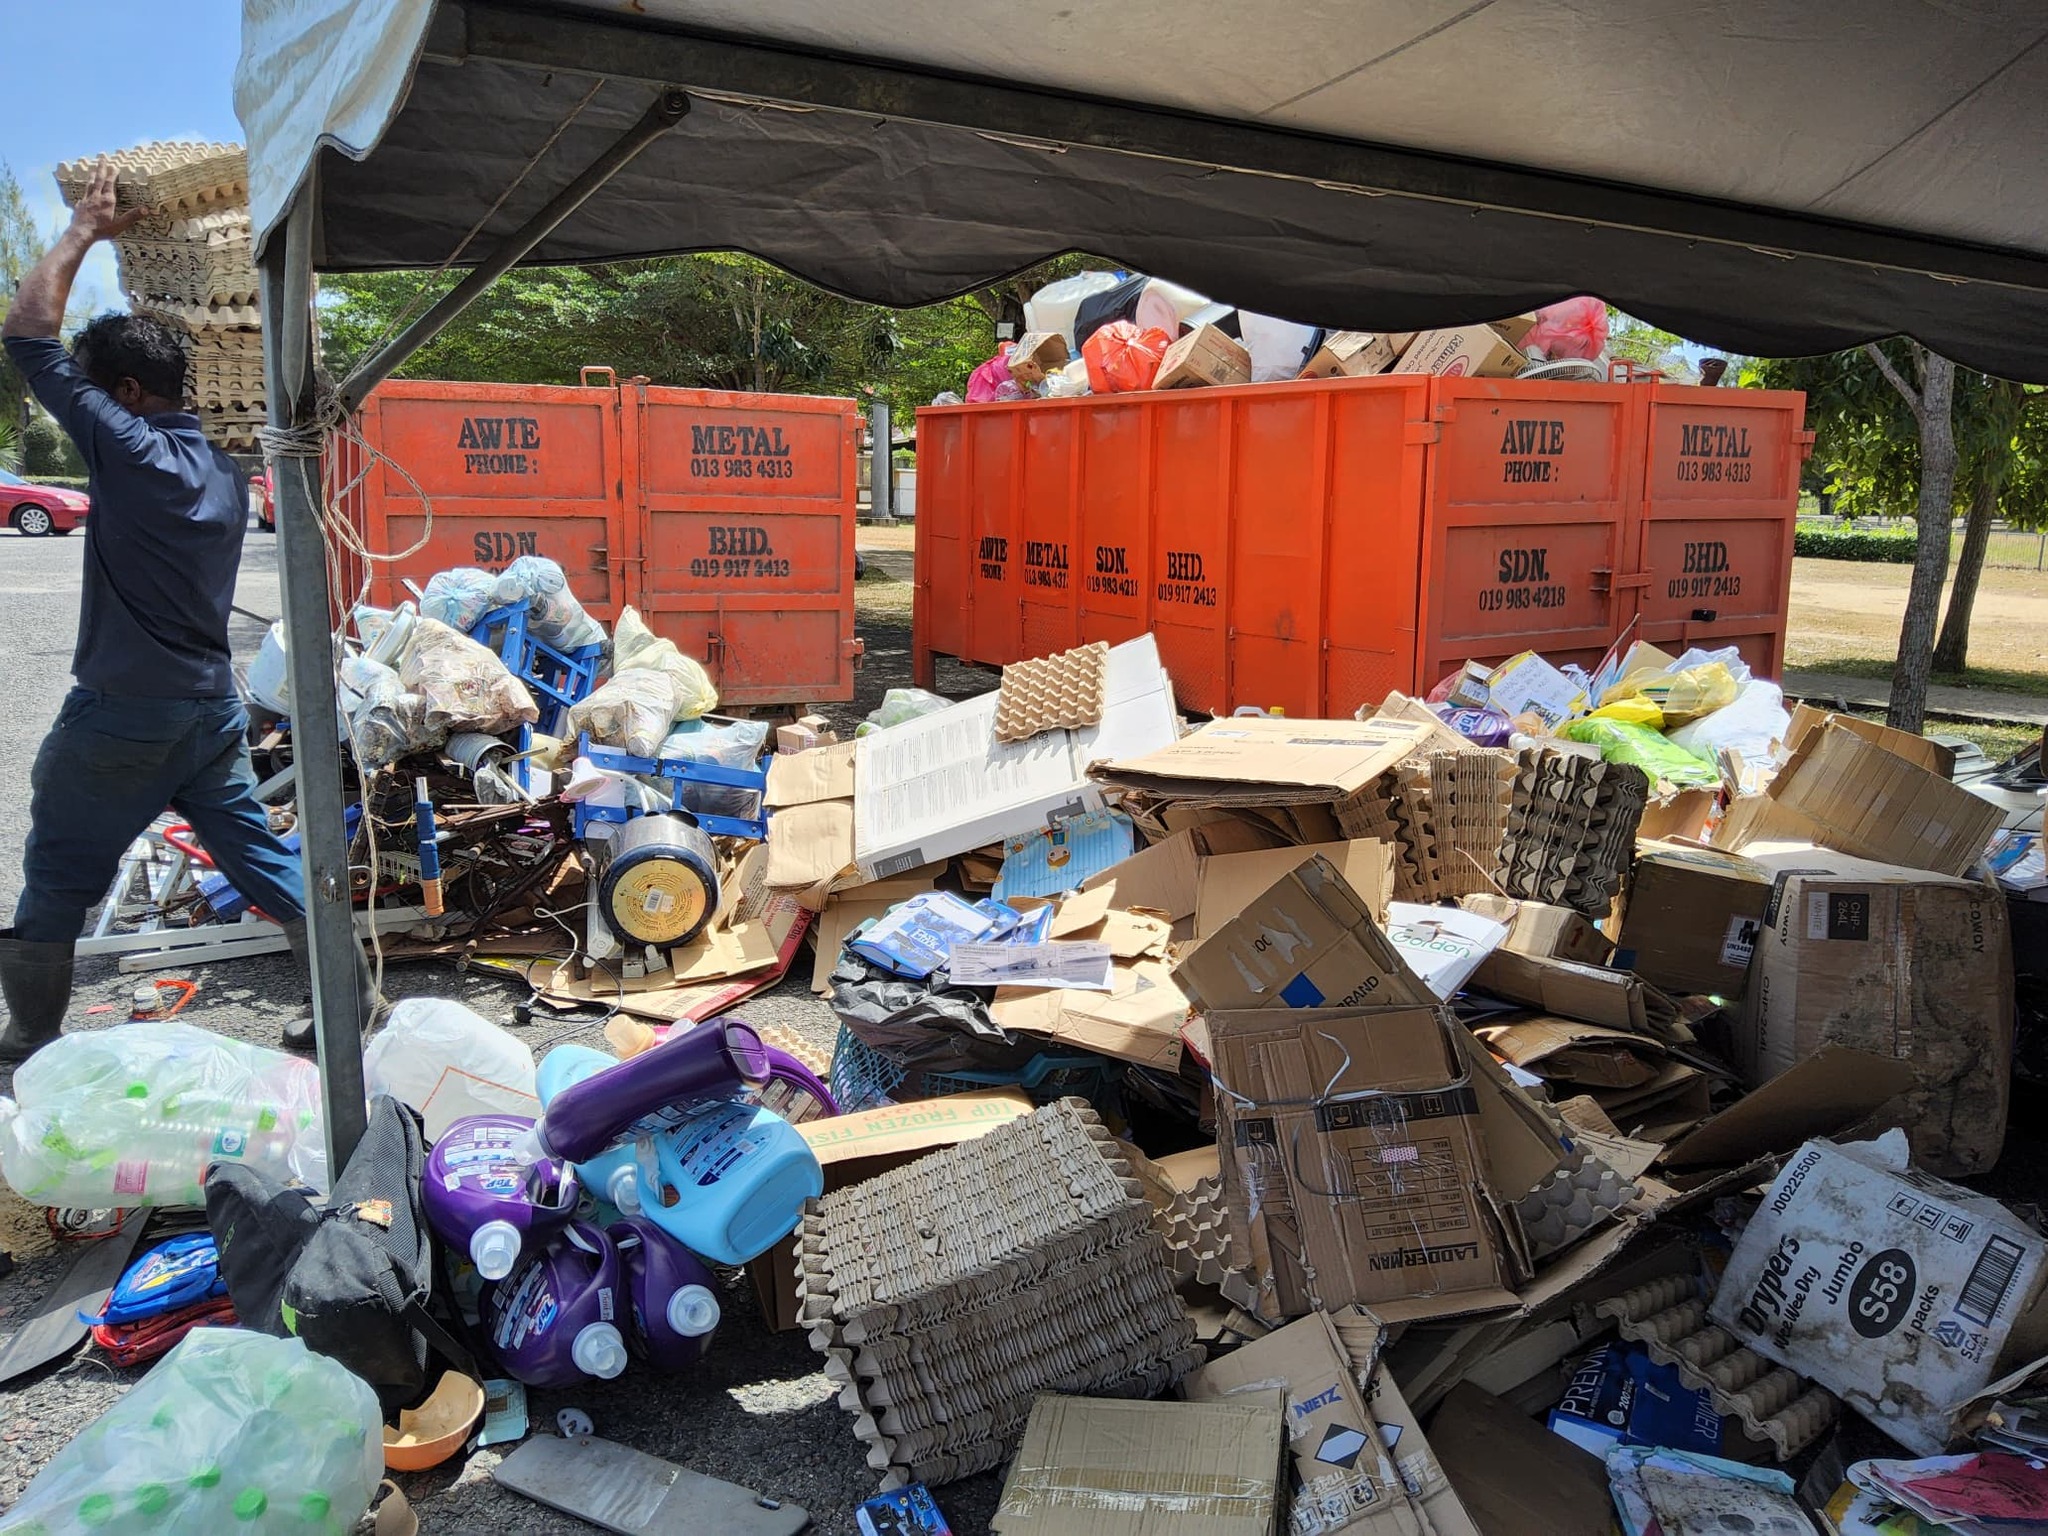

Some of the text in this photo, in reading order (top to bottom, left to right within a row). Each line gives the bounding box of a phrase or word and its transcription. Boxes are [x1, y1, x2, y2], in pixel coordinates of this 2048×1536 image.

[457, 417, 541, 450] AWIE
[691, 425, 791, 457] METAL
[1501, 420, 1565, 455] AWIE
[1680, 424, 1752, 458] METAL
[691, 458, 720, 478] 013
[757, 459, 793, 479] 4313
[1677, 461, 1752, 483] 013 983 4313
[708, 526, 774, 556] BHD.
[979, 536, 1009, 563] AWIE
[690, 558, 720, 577] 019
[723, 559, 751, 578] 917
[1096, 546, 1129, 575] SDN.
[1167, 551, 1206, 582] BHD.
[1498, 548, 1550, 584] SDN.
[1682, 542, 1730, 574] BHD.
[1157, 585, 1217, 606] 019 917 2413
[1478, 586, 1566, 612] 019 983 4218
[1667, 576, 1741, 599] 019 917 2413
[866, 1107, 958, 1133] FROZEN
[971, 1101, 1015, 1118] TOP
[1740, 1233, 1801, 1337] Drypers
[1800, 1265, 1822, 1293] Dry
[1822, 1241, 1864, 1305] Jumbo
[1858, 1260, 1908, 1324] S58
[1903, 1284, 1940, 1345] 4 packs
[1961, 1332, 1982, 1360] SCA
[1292, 1385, 1343, 1420] NIETZ
